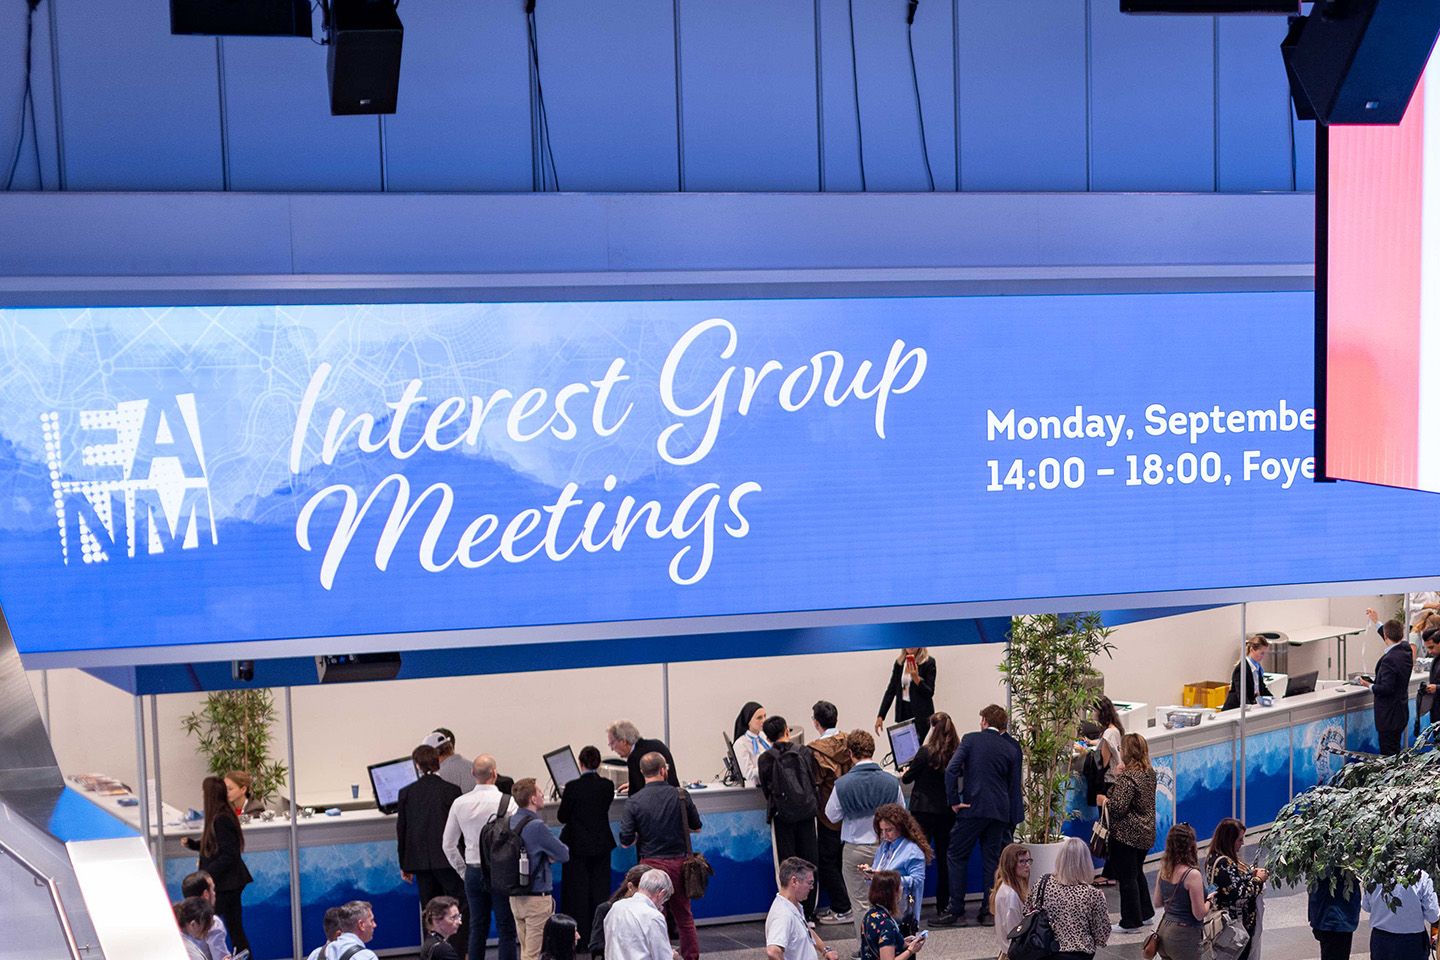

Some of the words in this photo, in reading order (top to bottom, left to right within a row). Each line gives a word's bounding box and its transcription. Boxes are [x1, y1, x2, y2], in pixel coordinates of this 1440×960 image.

[290, 357, 634, 474] Interest
[656, 317, 928, 466] Group
[986, 405, 1134, 447] Monday,
[1144, 399, 1316, 444] Septembe
[986, 456, 1086, 492] 14:00
[1125, 451, 1232, 487] 18:00,
[1243, 450, 1316, 489] Foye
[295, 473, 763, 591] Meetings
